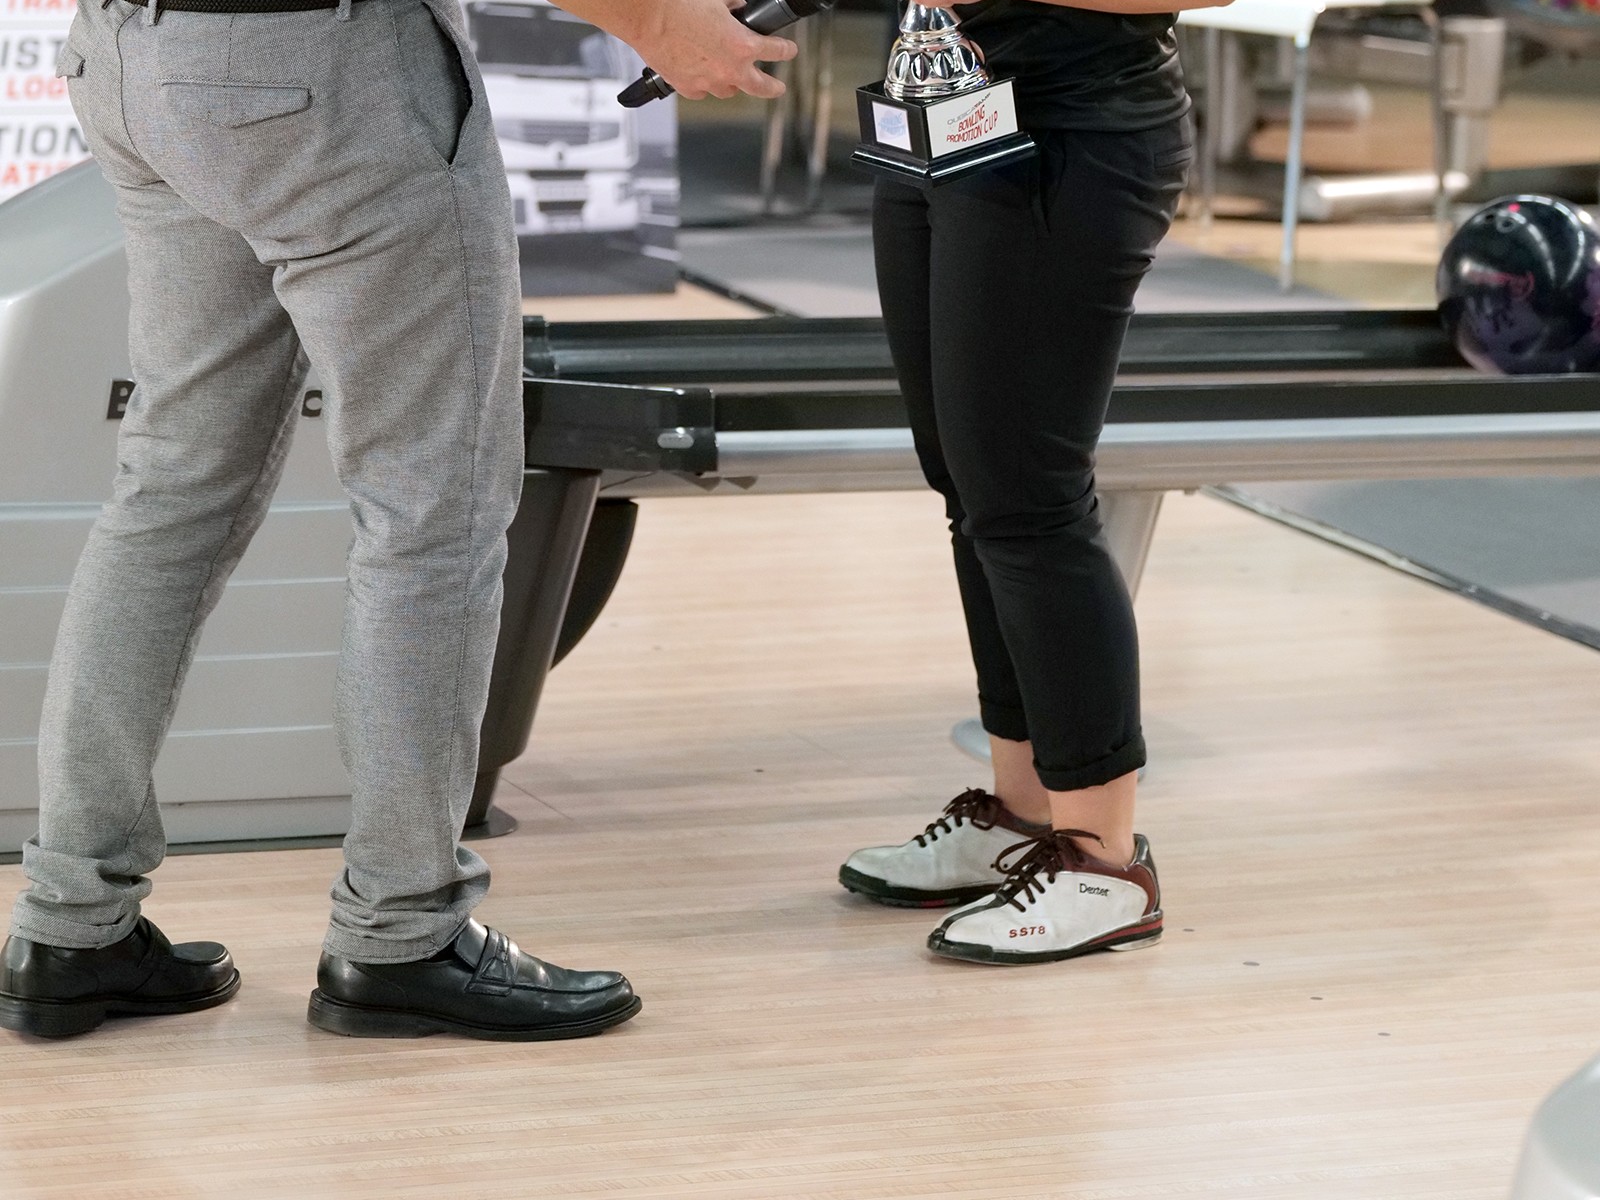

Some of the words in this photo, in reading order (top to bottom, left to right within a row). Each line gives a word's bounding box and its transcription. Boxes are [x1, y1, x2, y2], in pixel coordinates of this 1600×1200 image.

[946, 123, 983, 143] PROMOTION
[983, 110, 999, 134] CUP
[958, 104, 986, 132] BOWLING
[1079, 883, 1110, 897] Dexter
[1009, 926, 1046, 938] SST8
